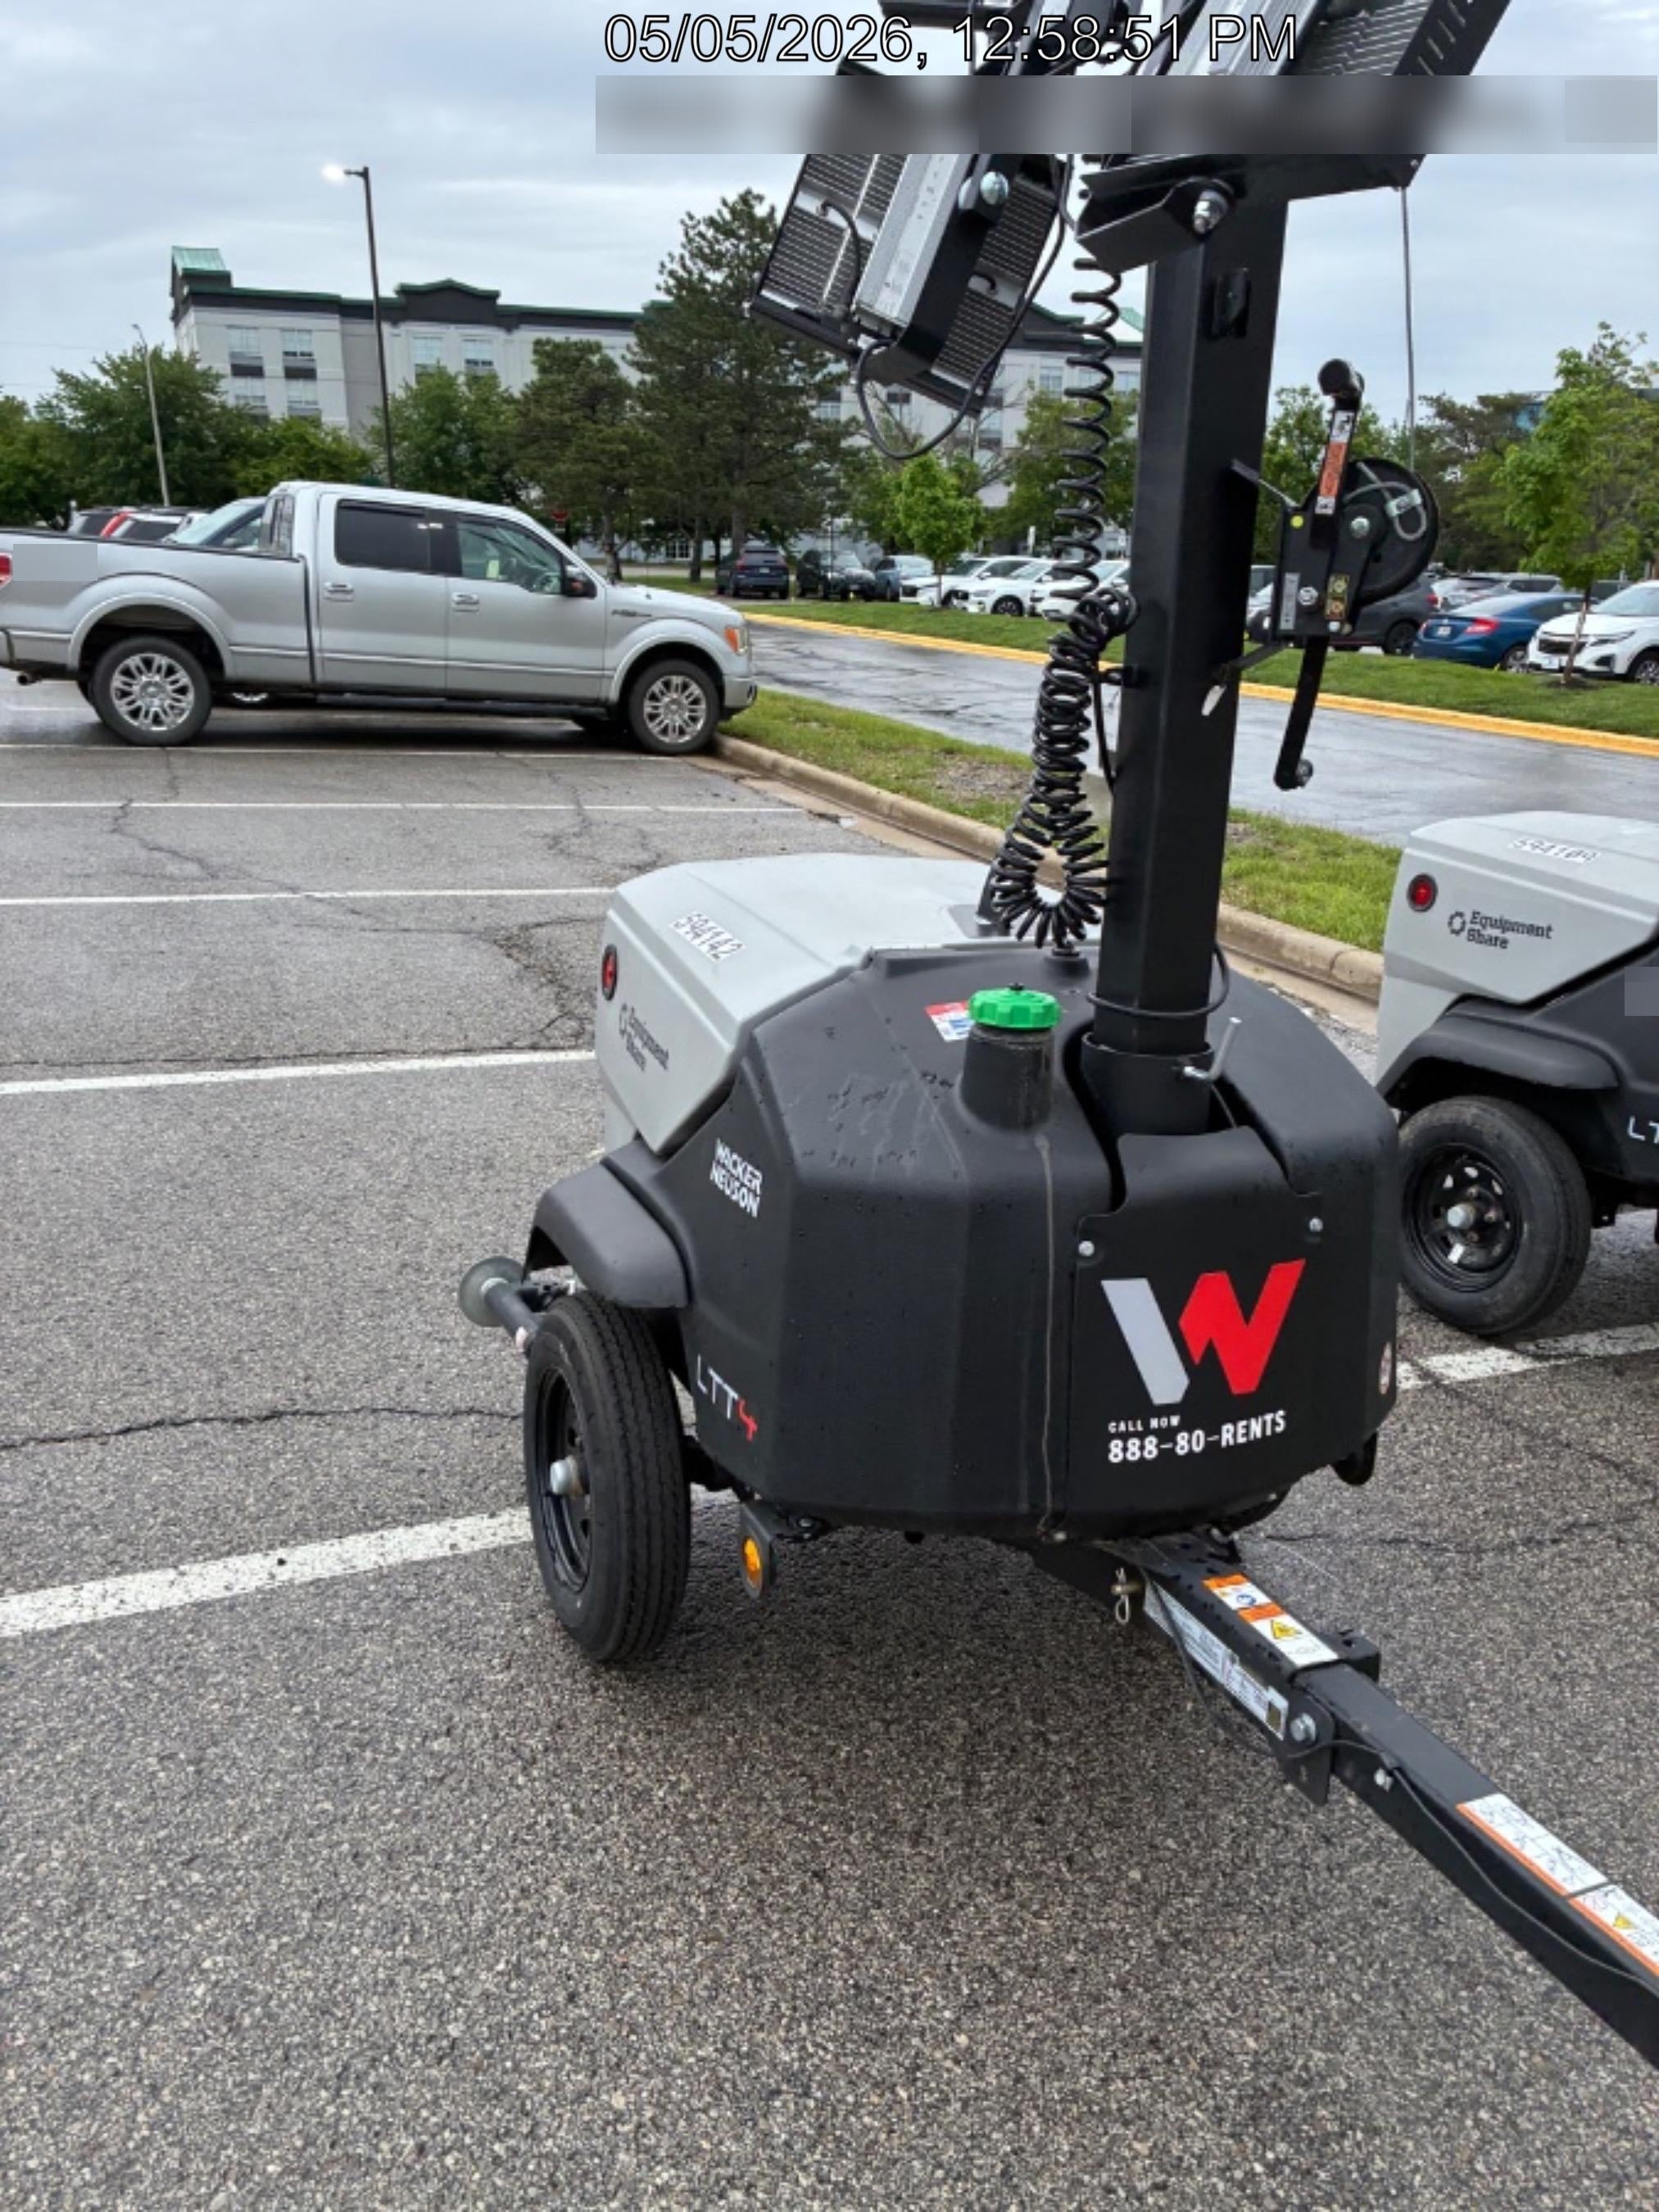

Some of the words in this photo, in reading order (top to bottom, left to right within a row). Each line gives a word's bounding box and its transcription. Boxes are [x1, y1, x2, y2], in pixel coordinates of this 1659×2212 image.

[1466, 927, 1509, 950] Share
[1469, 910, 1553, 940] Equipment
[709, 1160, 761, 1217] NEUSON
[714, 1138, 763, 1195] WACKER
[696, 1353, 758, 1442] LTT4
[1108, 1419, 1144, 1433] CALL
[1149, 1415, 1181, 1429] NOW
[1108, 1409, 1286, 1463] 888-80-RENTS
